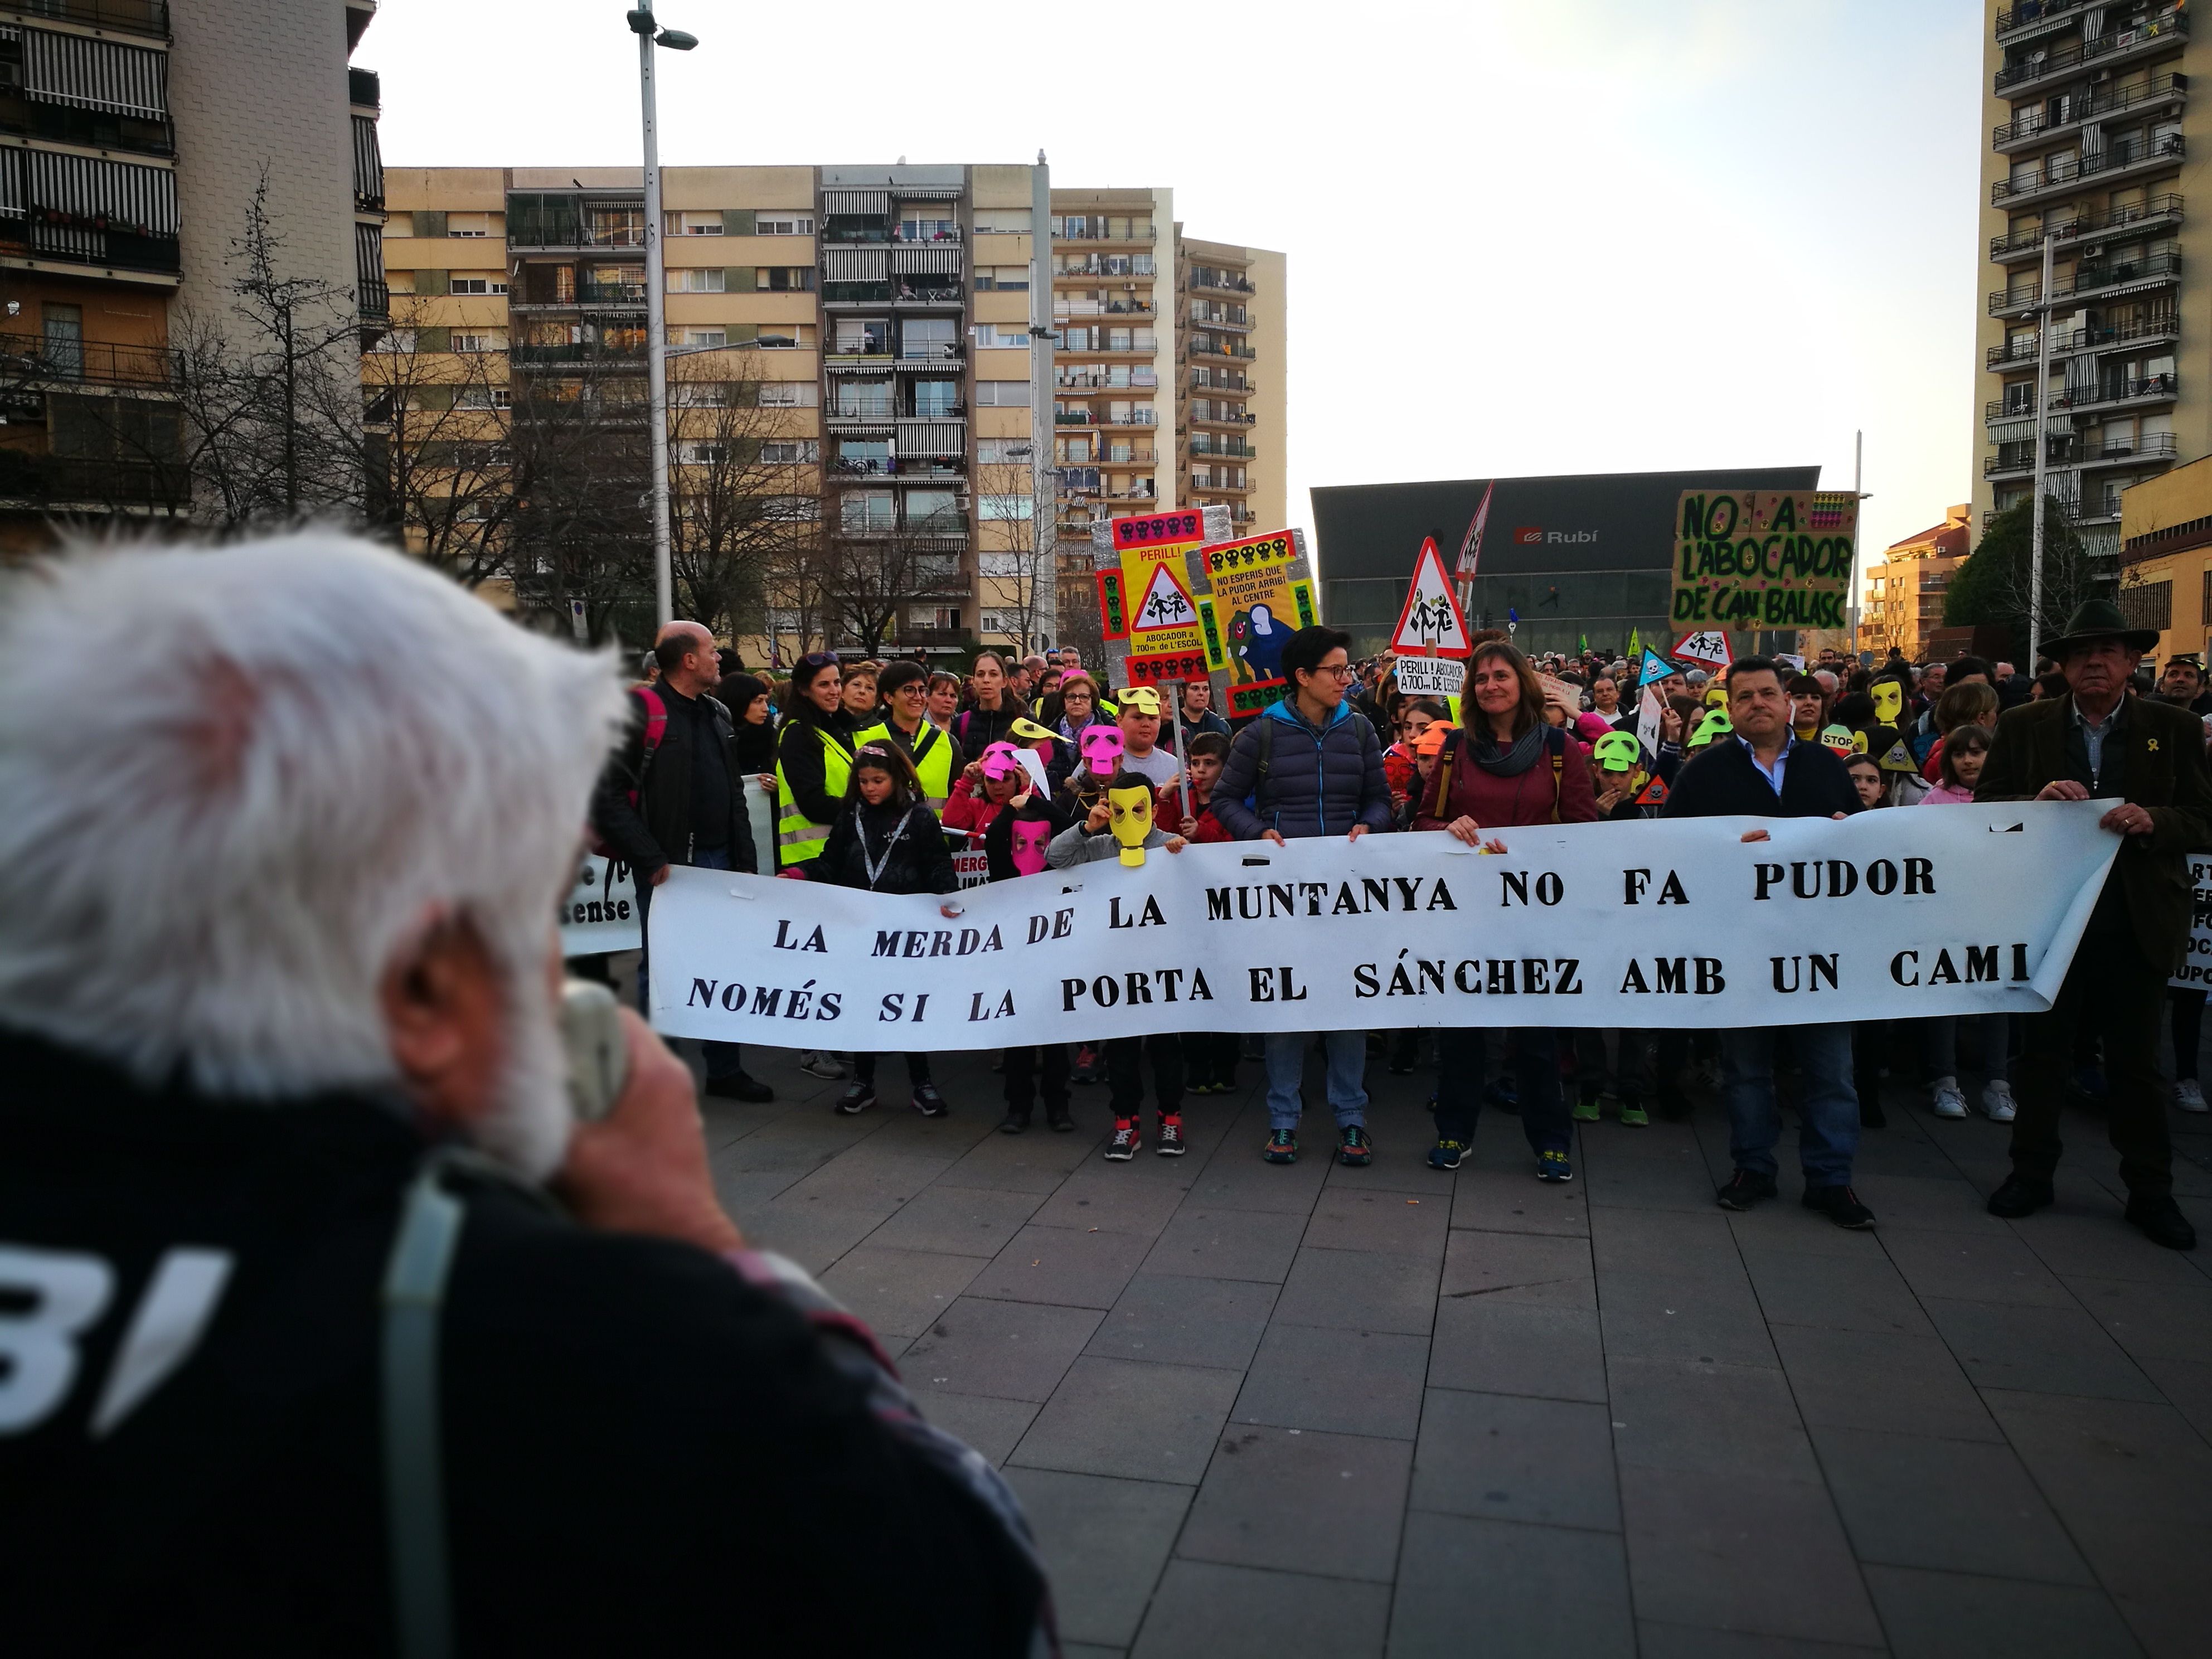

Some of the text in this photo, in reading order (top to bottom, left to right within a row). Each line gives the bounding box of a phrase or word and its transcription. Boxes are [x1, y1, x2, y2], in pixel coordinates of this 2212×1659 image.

[1682, 494, 1796, 541] NO A
[1547, 530, 1599, 544] Rubí
[1140, 546, 1181, 562] PERILL!
[1682, 535, 1853, 580] L'ABOCADOR
[1217, 565, 1282, 586] NO ESPERIS QUE
[1217, 576, 1286, 598] LA PUDOR ARRIBI
[1232, 589, 1275, 605] AL CENTRE
[1673, 585, 1709, 620] DE
[1711, 586, 1760, 620] CAN
[1146, 631, 1187, 642] ABOCADOR
[1171, 639, 1203, 649] L'ESCOL
[1435, 662, 1463, 679] ABOCADOR
[1433, 676, 1442, 691] DE
[1823, 735, 1853, 746] STOP
[773, 858, 1936, 958] LA MERDA DE LA MUNTANYA NO FA PUDOR
[687, 943, 2030, 1022] NOMÉS SI LA PORTA EL SÁNCHEZ AMB UN CAMI
